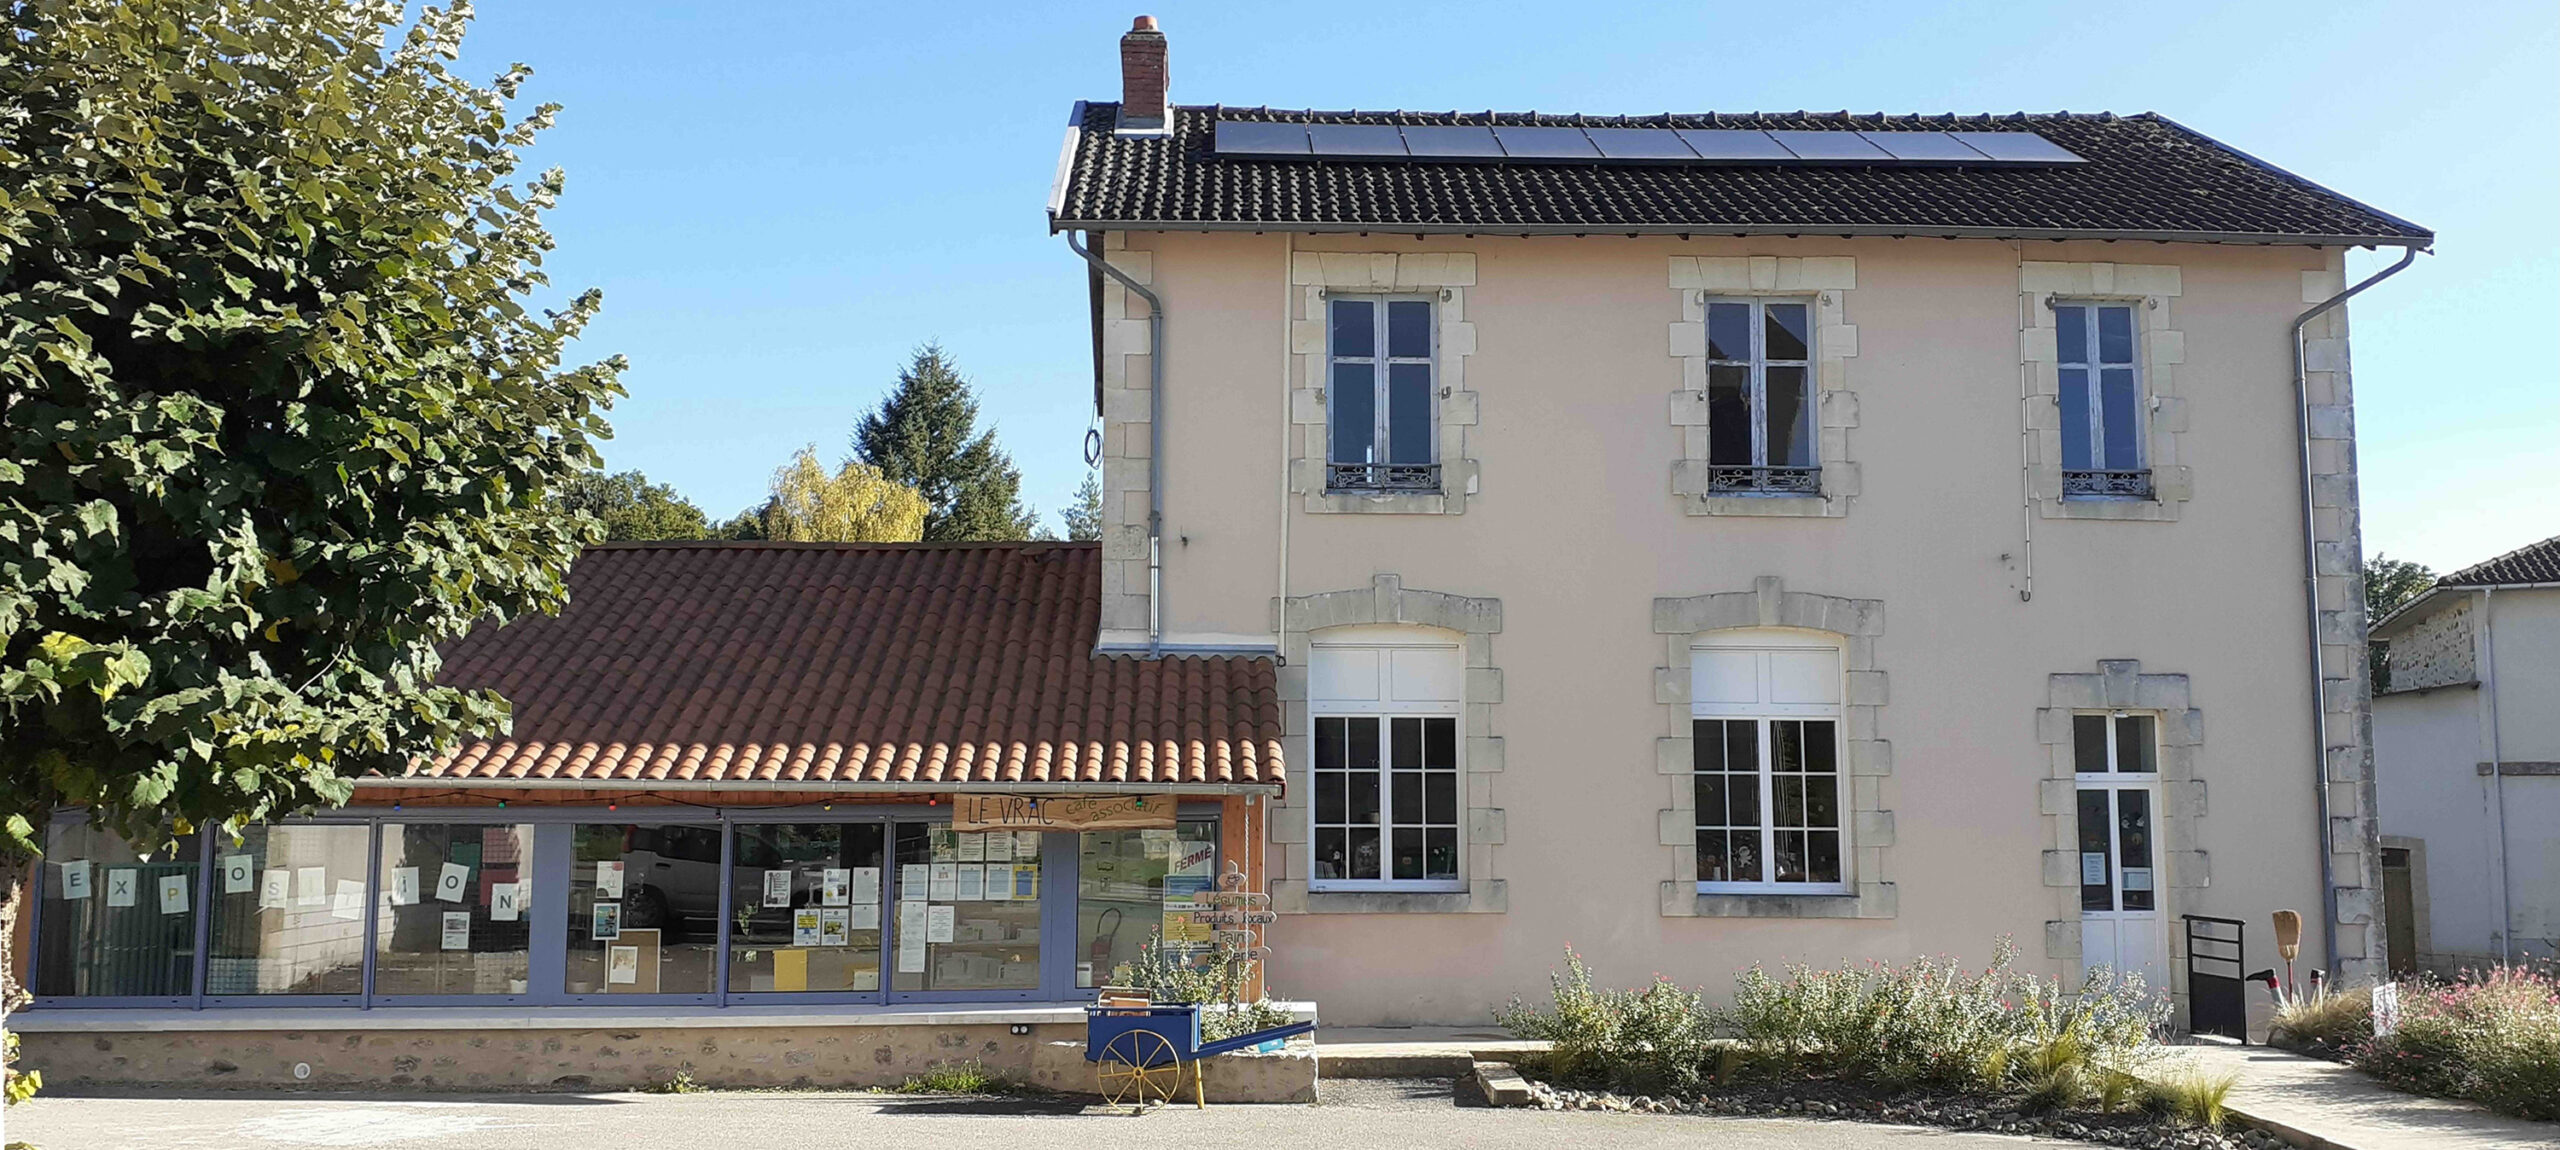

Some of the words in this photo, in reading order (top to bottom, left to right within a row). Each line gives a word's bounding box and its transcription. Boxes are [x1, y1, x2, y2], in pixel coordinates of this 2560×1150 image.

[968, 797, 989, 825] LE
[999, 797, 1055, 825] VRAC
[1193, 911, 1234, 925] Produits
